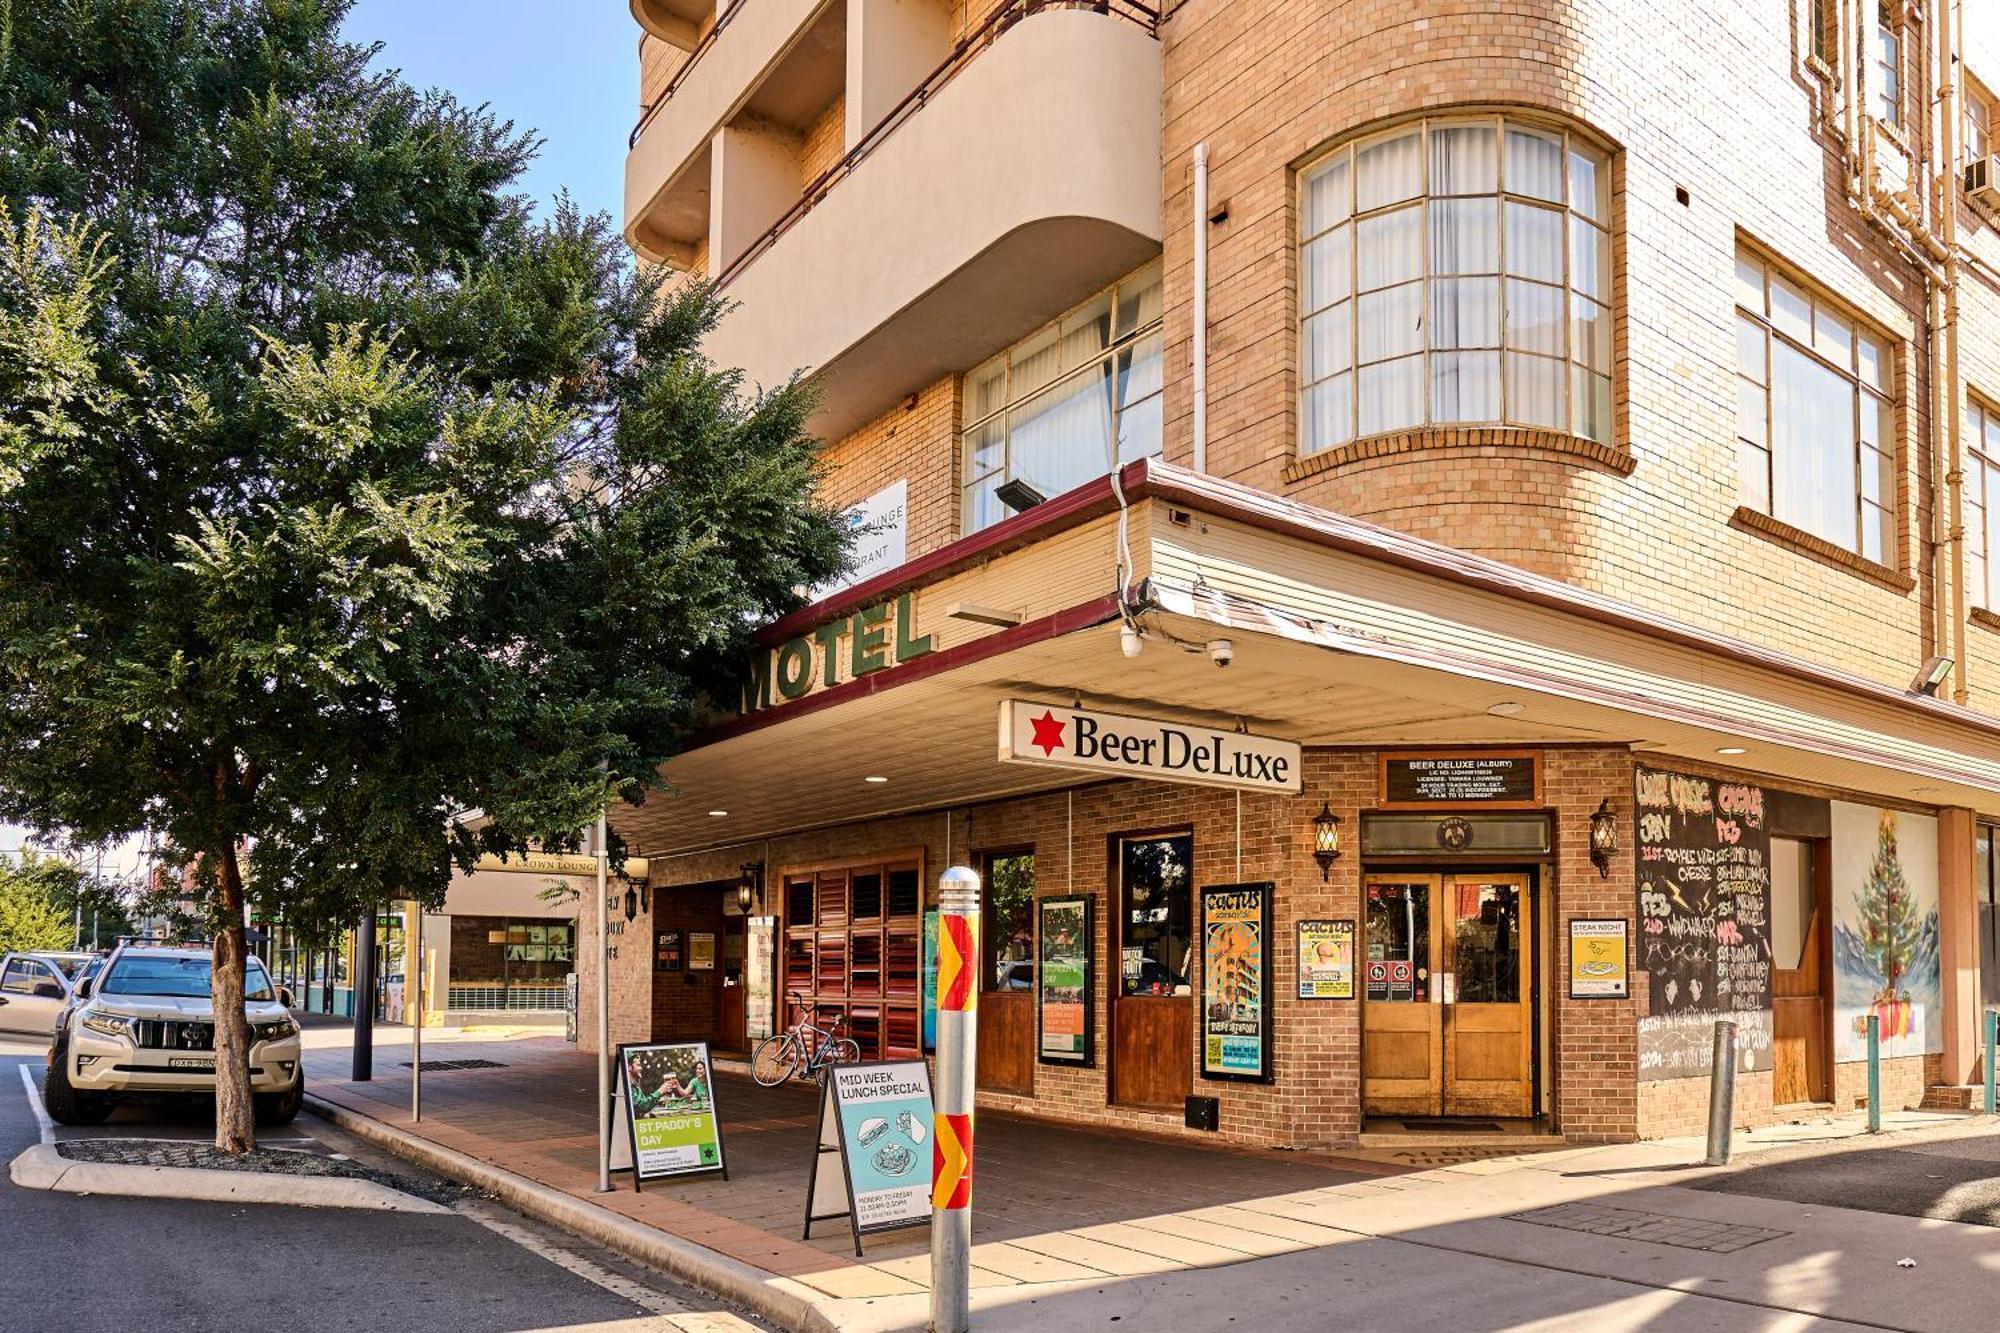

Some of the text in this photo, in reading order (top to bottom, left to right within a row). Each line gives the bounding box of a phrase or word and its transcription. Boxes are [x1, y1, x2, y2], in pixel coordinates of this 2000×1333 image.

[1409, 760, 1513, 770] BEER DELUXE (ALBURY)
[1640, 813, 1671, 843] JAN
[515, 860, 554, 869] CROWN
[1640, 892, 1671, 917] FEB
[840, 1072, 894, 1086] MID WEEK
[842, 1082, 925, 1099] LUNCH SPECIAL
[640, 1135, 662, 1146] DAY
